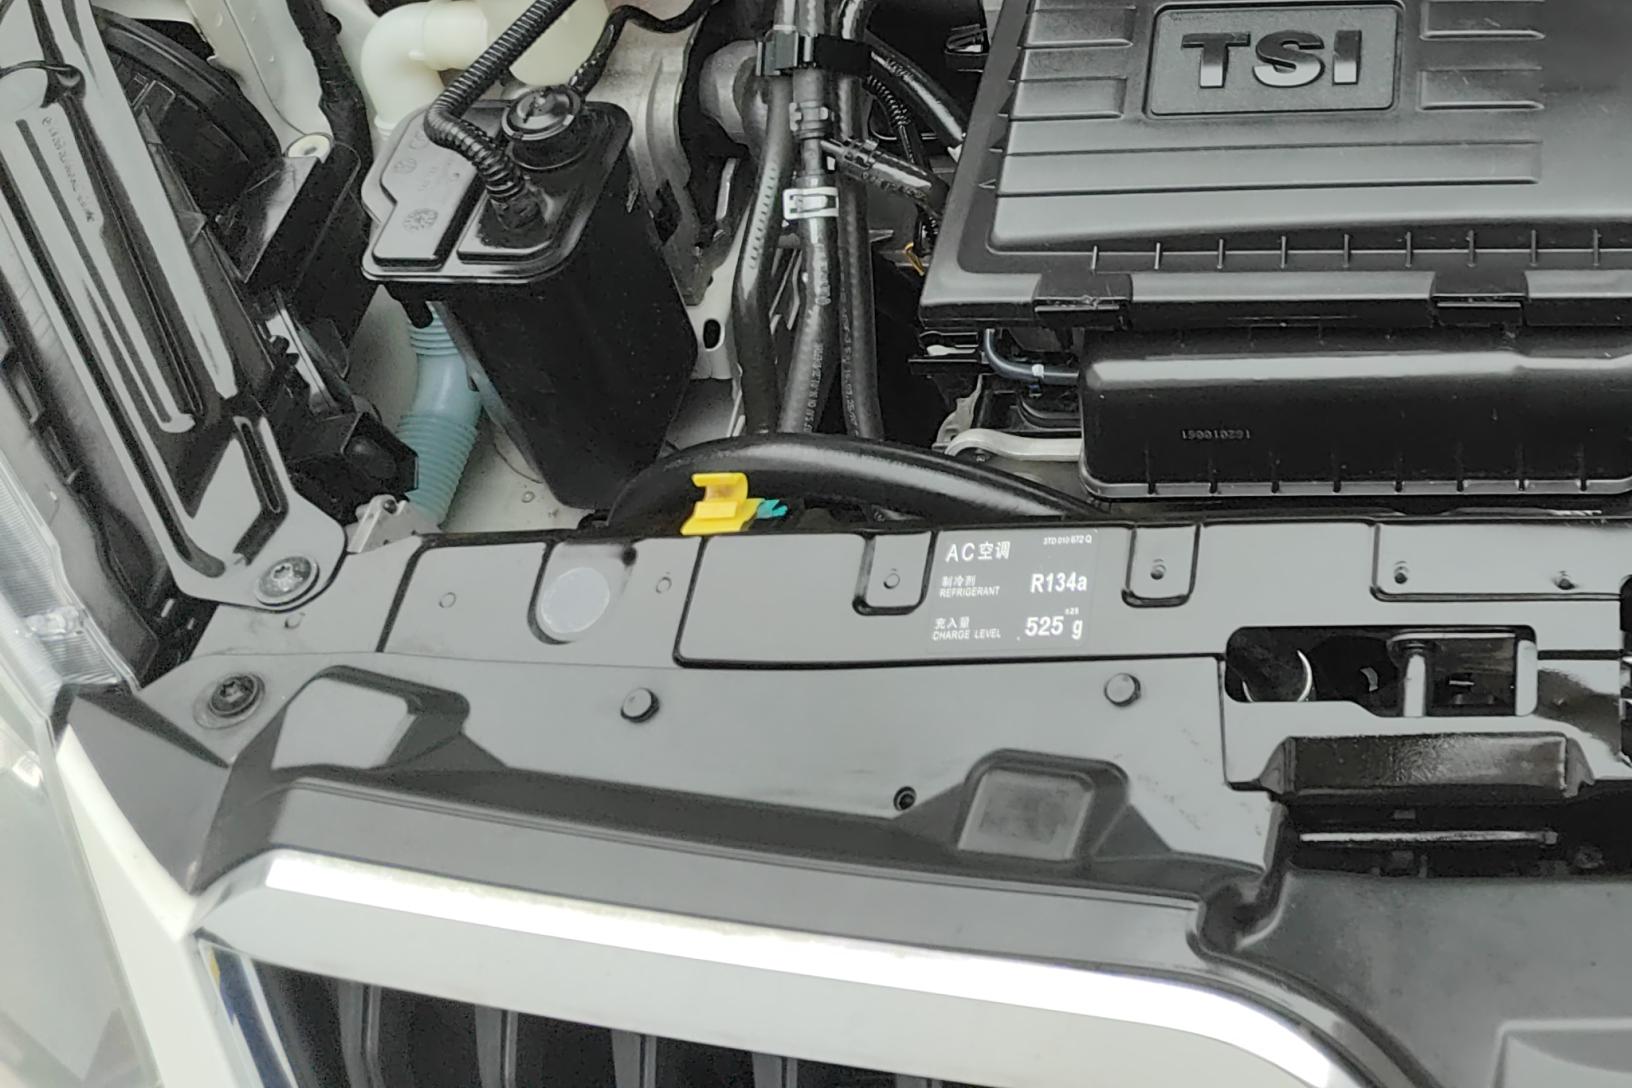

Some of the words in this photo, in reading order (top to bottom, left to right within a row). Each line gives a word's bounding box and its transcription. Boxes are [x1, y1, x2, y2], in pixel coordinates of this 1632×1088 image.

[1181, 29, 1363, 89] TSI
[942, 574, 977, 588] 制冷剂
[1030, 571, 1088, 594] R134a
[939, 585, 1001, 599] REFRIGERANT
[934, 615, 970, 630] 充入量
[1024, 615, 1065, 637] 525
[1071, 619, 1084, 641] g
[931, 629, 971, 641] CHARGE
[973, 627, 1002, 640] LEVEL
